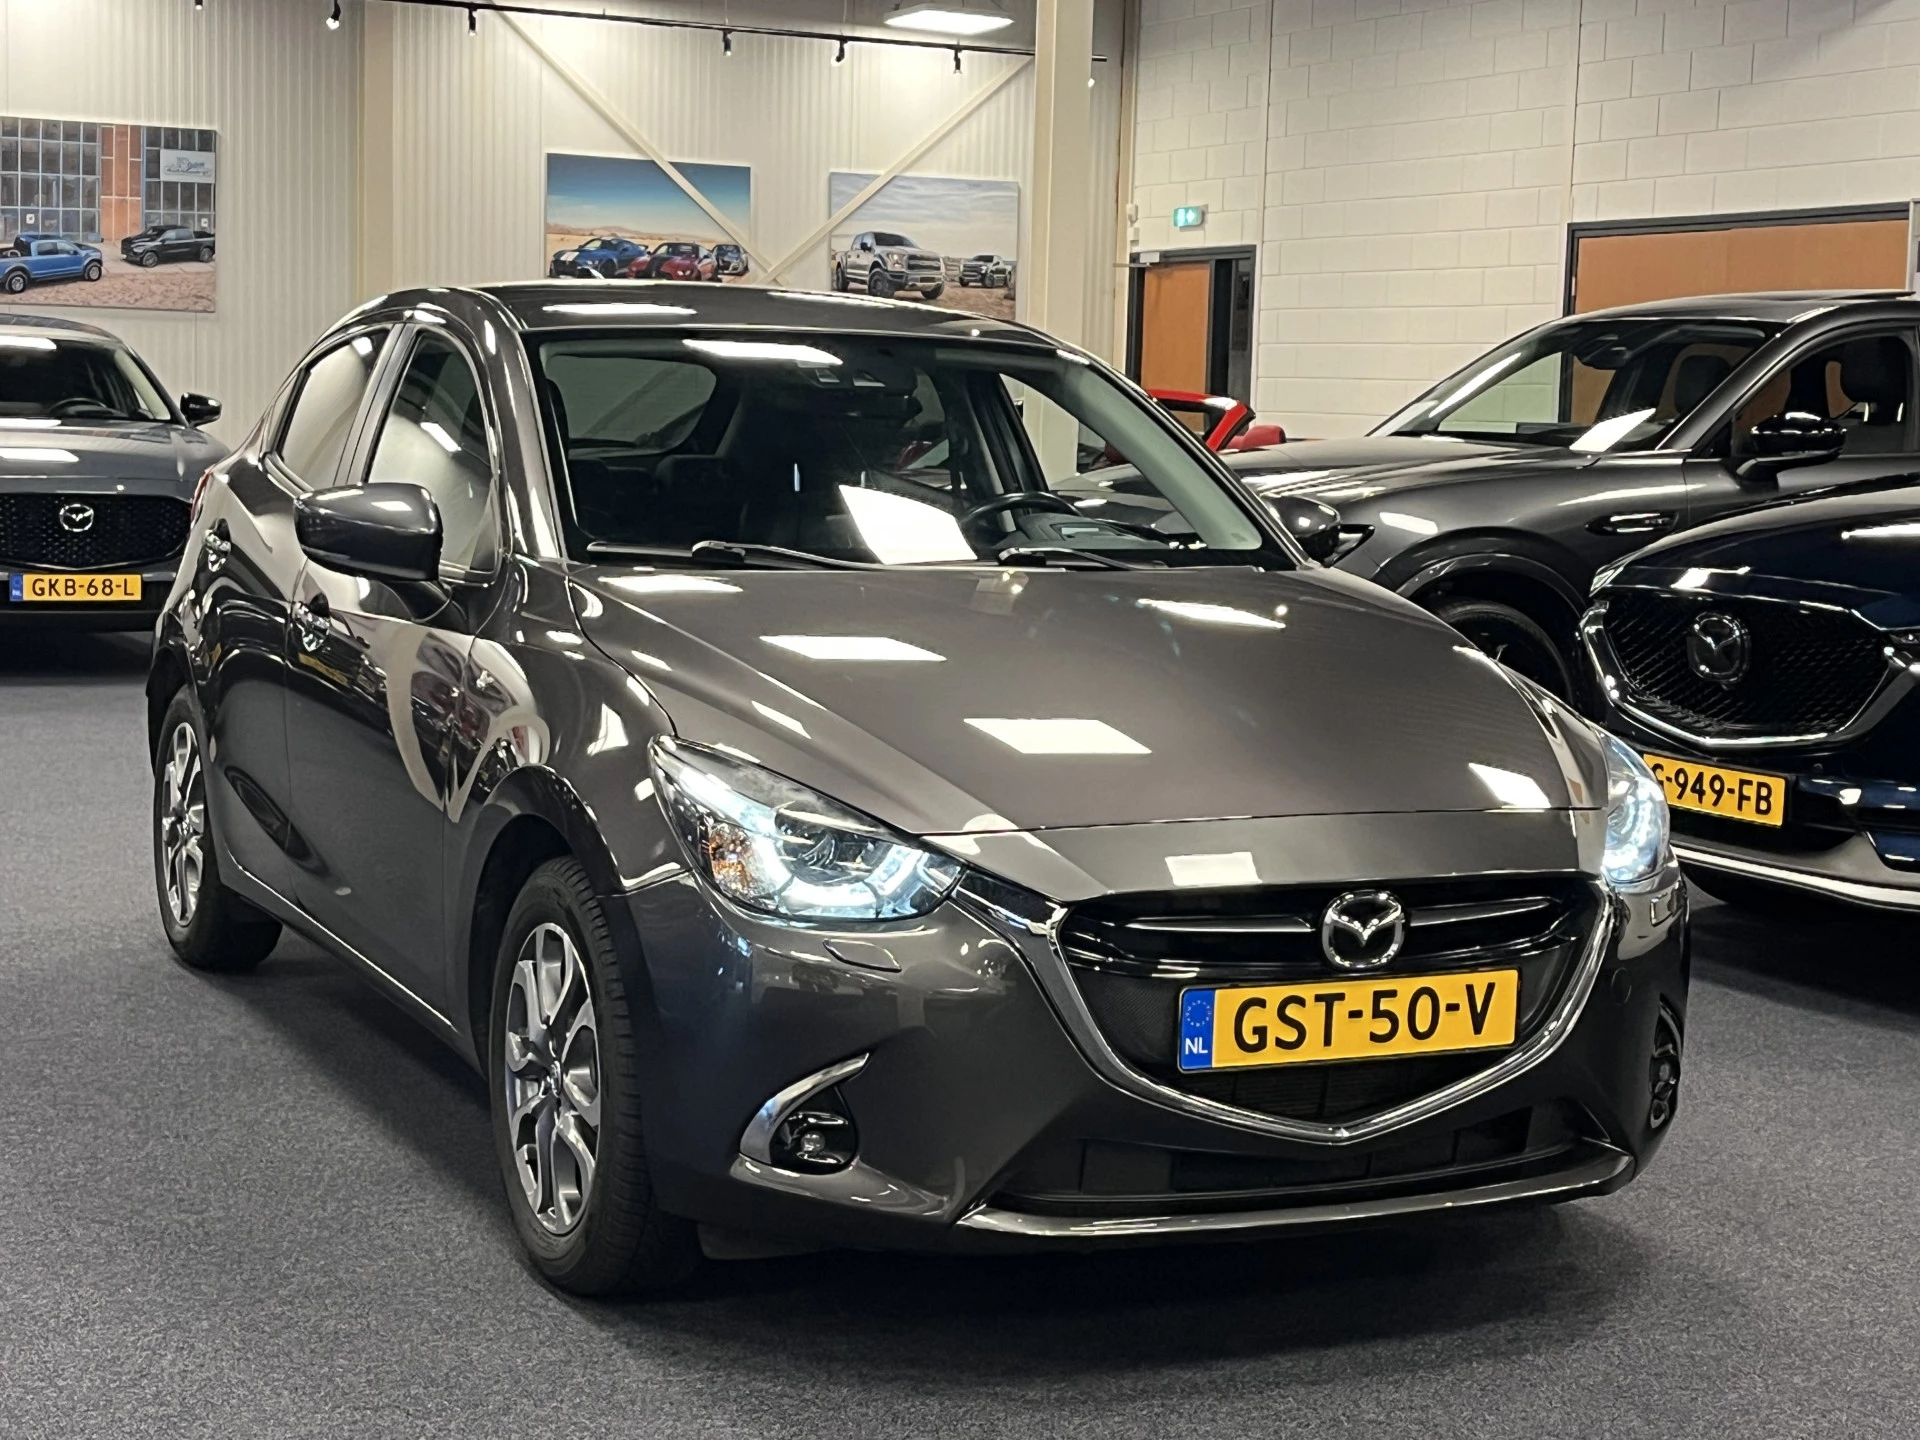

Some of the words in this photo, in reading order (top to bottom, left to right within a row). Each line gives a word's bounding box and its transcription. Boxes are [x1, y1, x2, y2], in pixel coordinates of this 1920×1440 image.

[31, 578, 135, 597] GKB-68-L
[1233, 982, 1496, 1054] GST-50-V
[1185, 1036, 1209, 1055] NL
